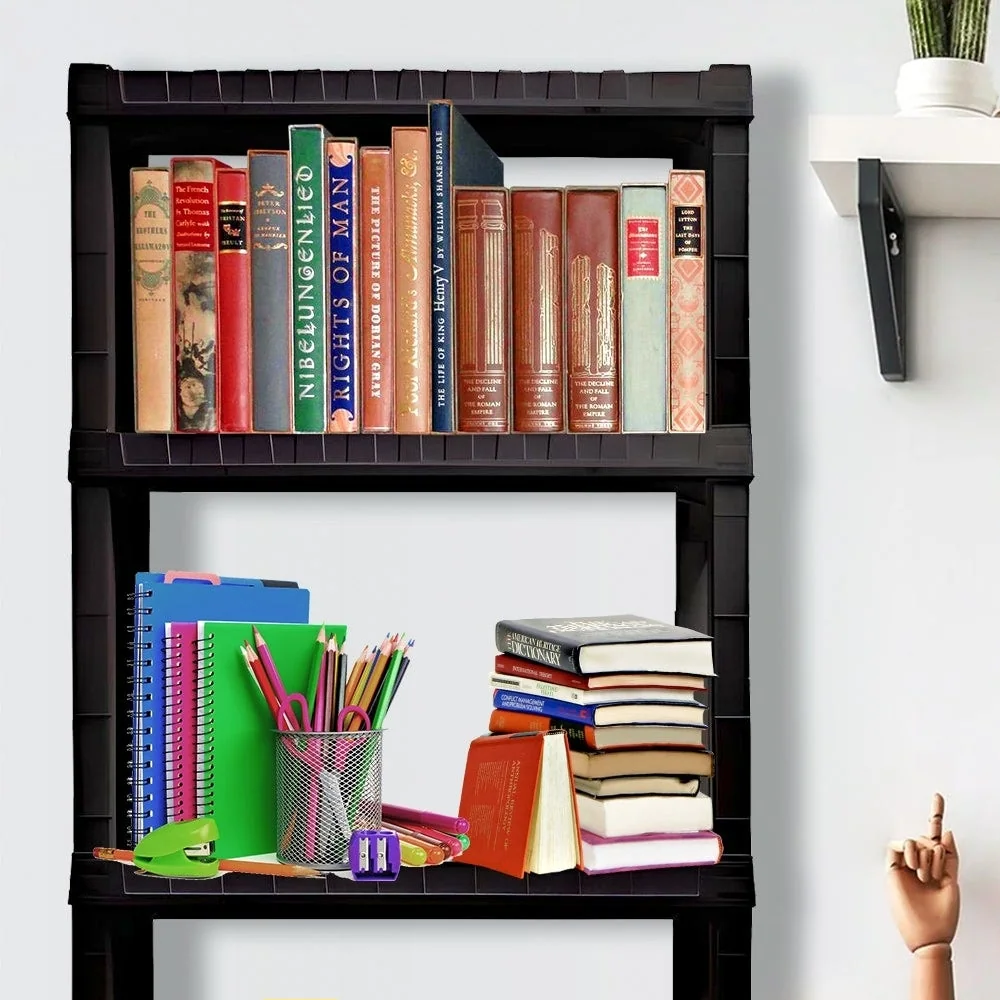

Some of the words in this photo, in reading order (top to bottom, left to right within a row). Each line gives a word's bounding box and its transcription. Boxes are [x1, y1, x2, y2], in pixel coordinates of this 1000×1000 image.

[436, 129, 444, 197] SHAKESPEARE
[187, 185, 209, 193] French
[371, 186, 381, 215] THE
[183, 208, 210, 216] Thomas
[332, 177, 349, 238] MAN
[371, 219, 381, 279] PICTURE
[437, 245, 444, 259] BY
[333, 251, 350, 284] OF
[433, 264, 444, 275] V
[371, 283, 381, 300] OF
[433, 276, 450, 312] Henry
[371, 303, 382, 360] DORIAN
[333, 297, 351, 402] RIGHTS
[438, 345, 445, 359] OF
[371, 362, 382, 398] GRAY
[511, 640, 562, 667] DICTIONARY
